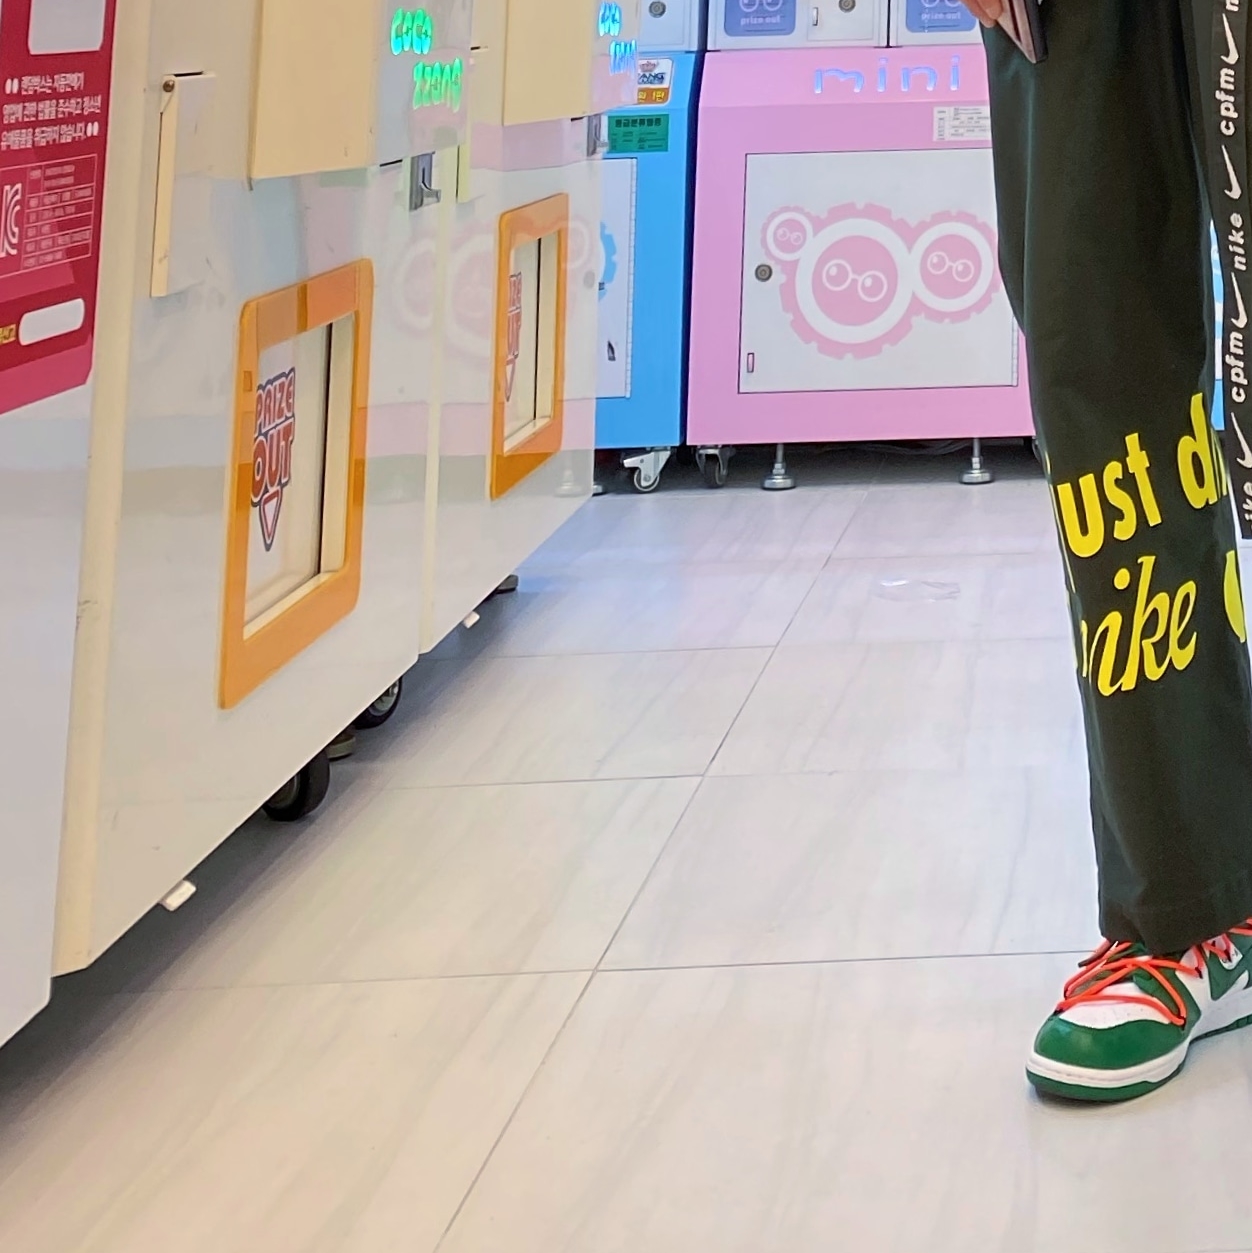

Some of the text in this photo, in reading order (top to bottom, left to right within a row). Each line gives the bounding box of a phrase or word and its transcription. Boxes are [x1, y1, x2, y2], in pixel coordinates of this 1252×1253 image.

[740, 15, 764, 26] prize
[813, 55, 962, 94] mini
[1215, 67, 1239, 136] cpfm
[1228, 212, 1247, 271] nike
[1225, 333, 1249, 404] cpfm
[255, 370, 295, 438] PRIZE
[251, 418, 294, 504] OUT
[1052, 392, 1224, 558] ust d
